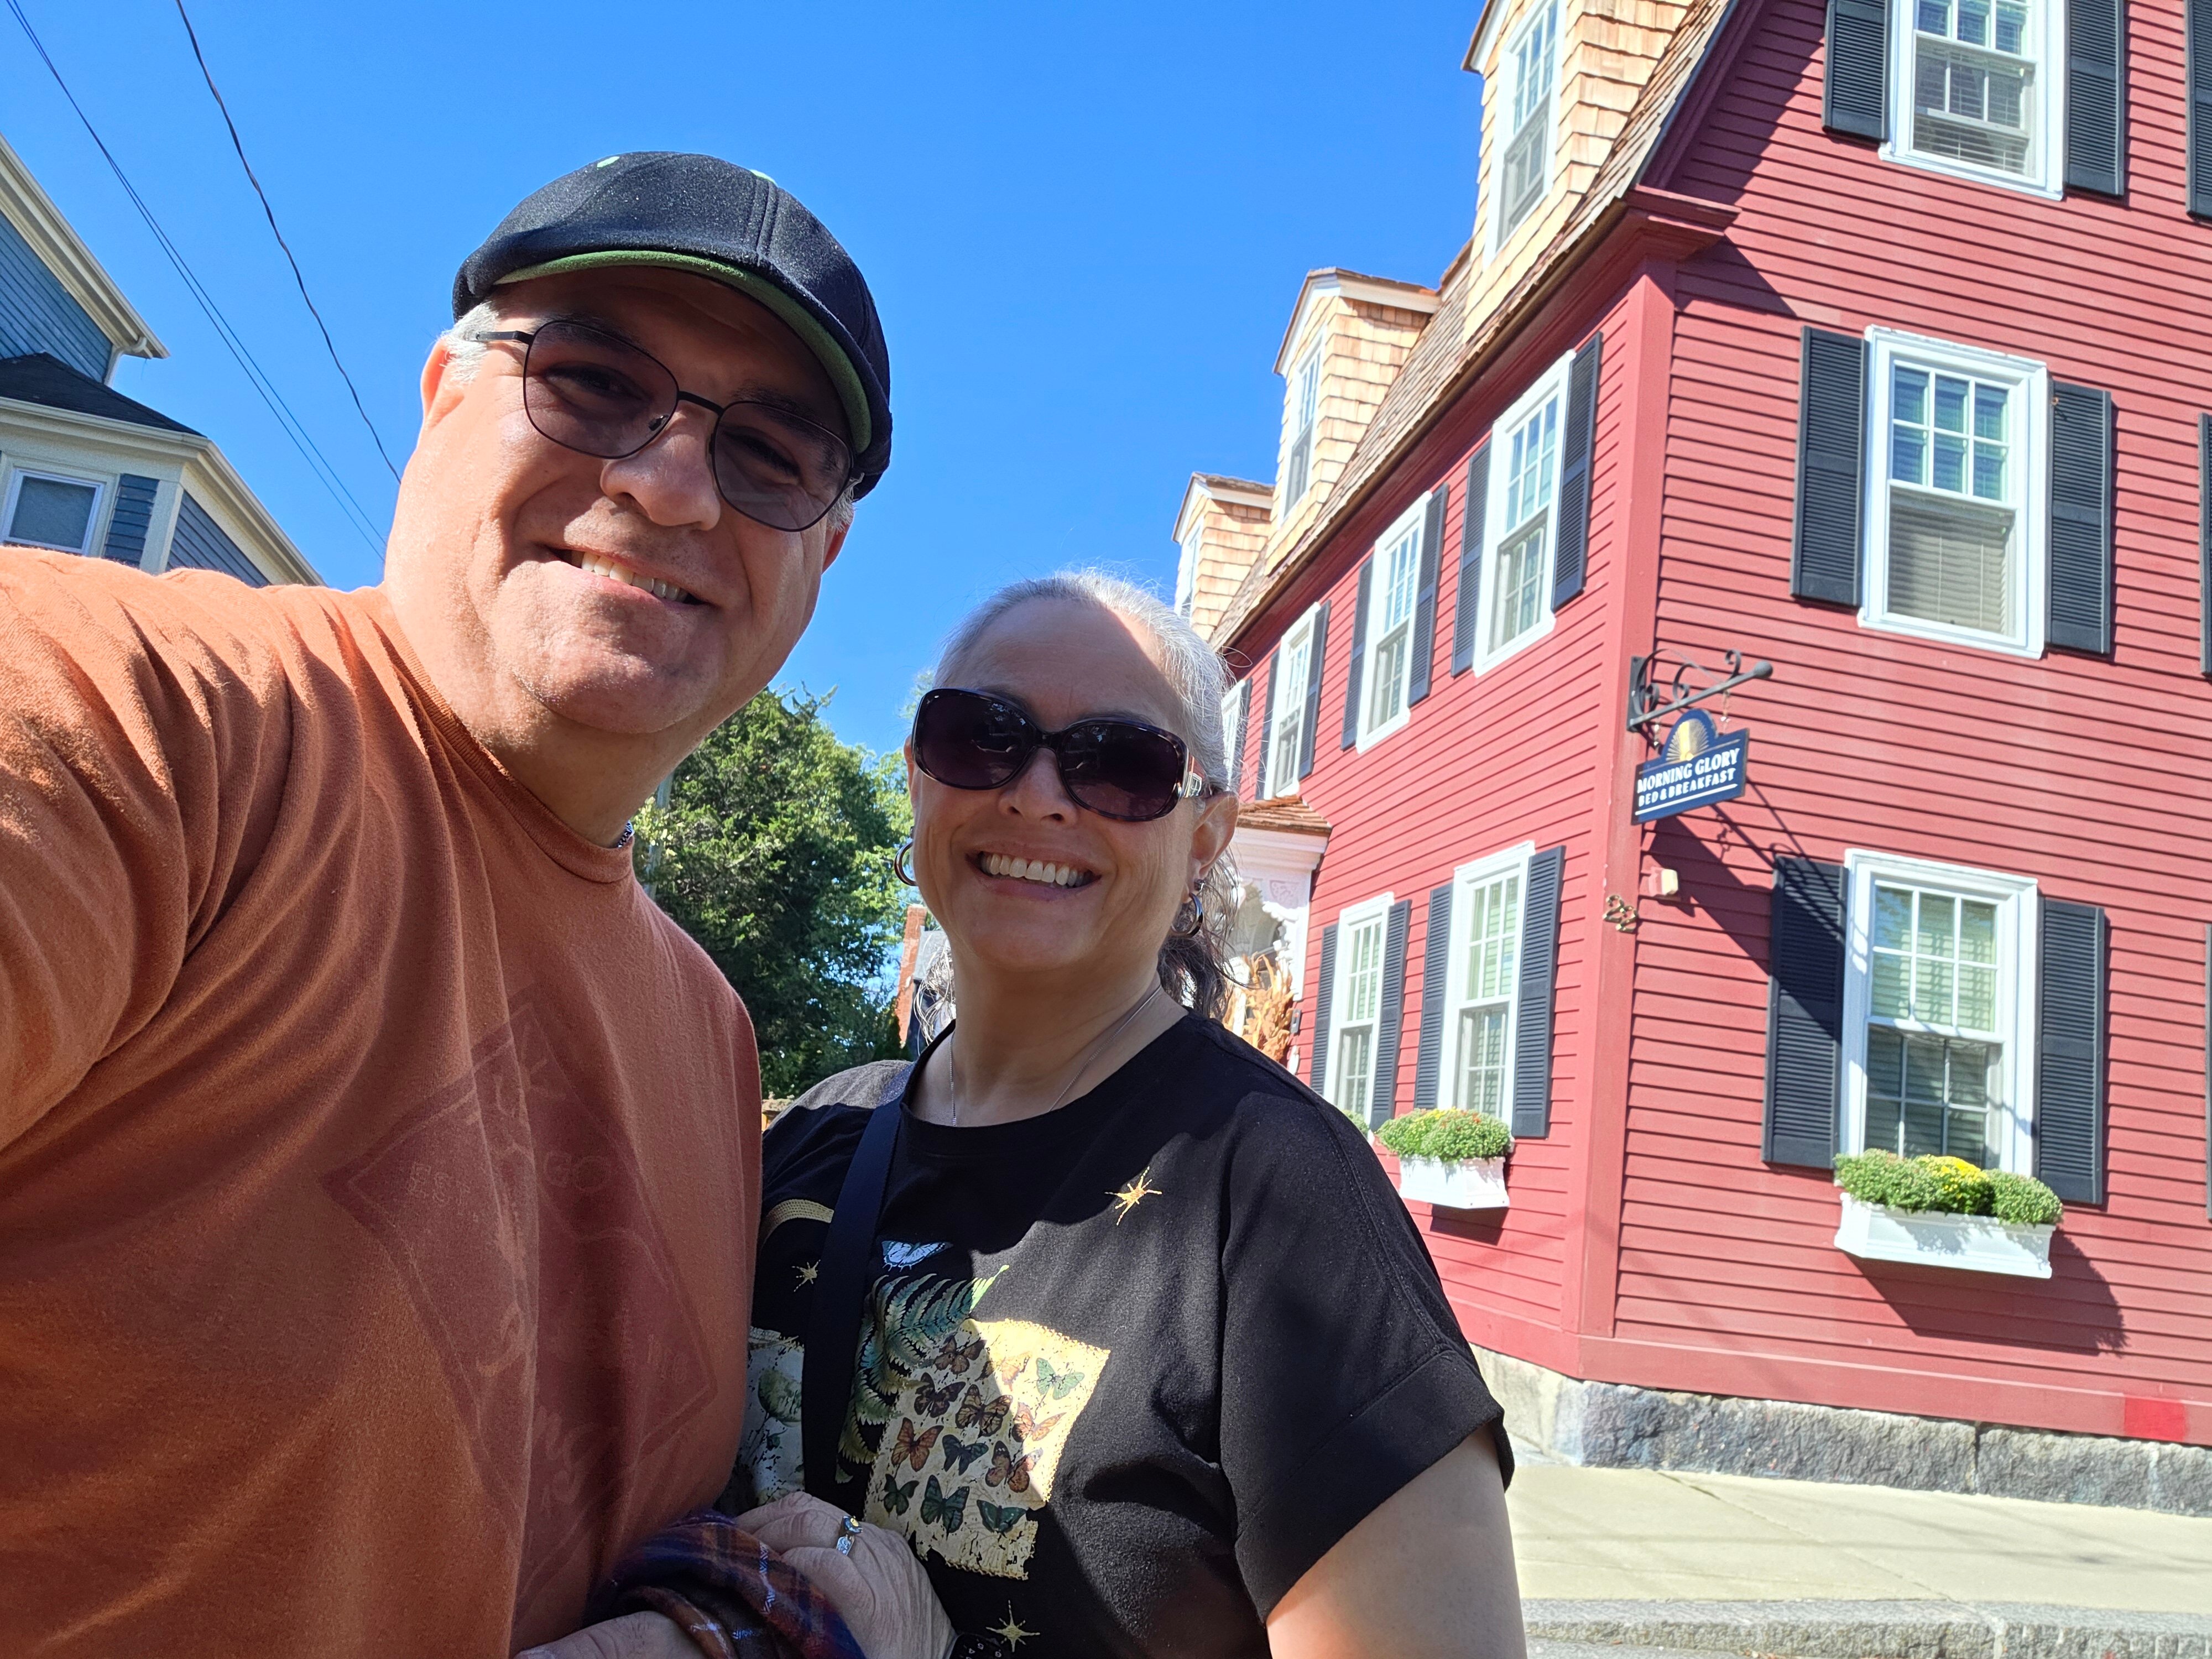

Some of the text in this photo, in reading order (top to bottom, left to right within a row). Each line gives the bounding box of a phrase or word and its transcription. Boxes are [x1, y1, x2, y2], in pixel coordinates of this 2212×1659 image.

[1637, 748, 1740, 794] MORNING GLORY
[1602, 895, 1637, 933] 22
